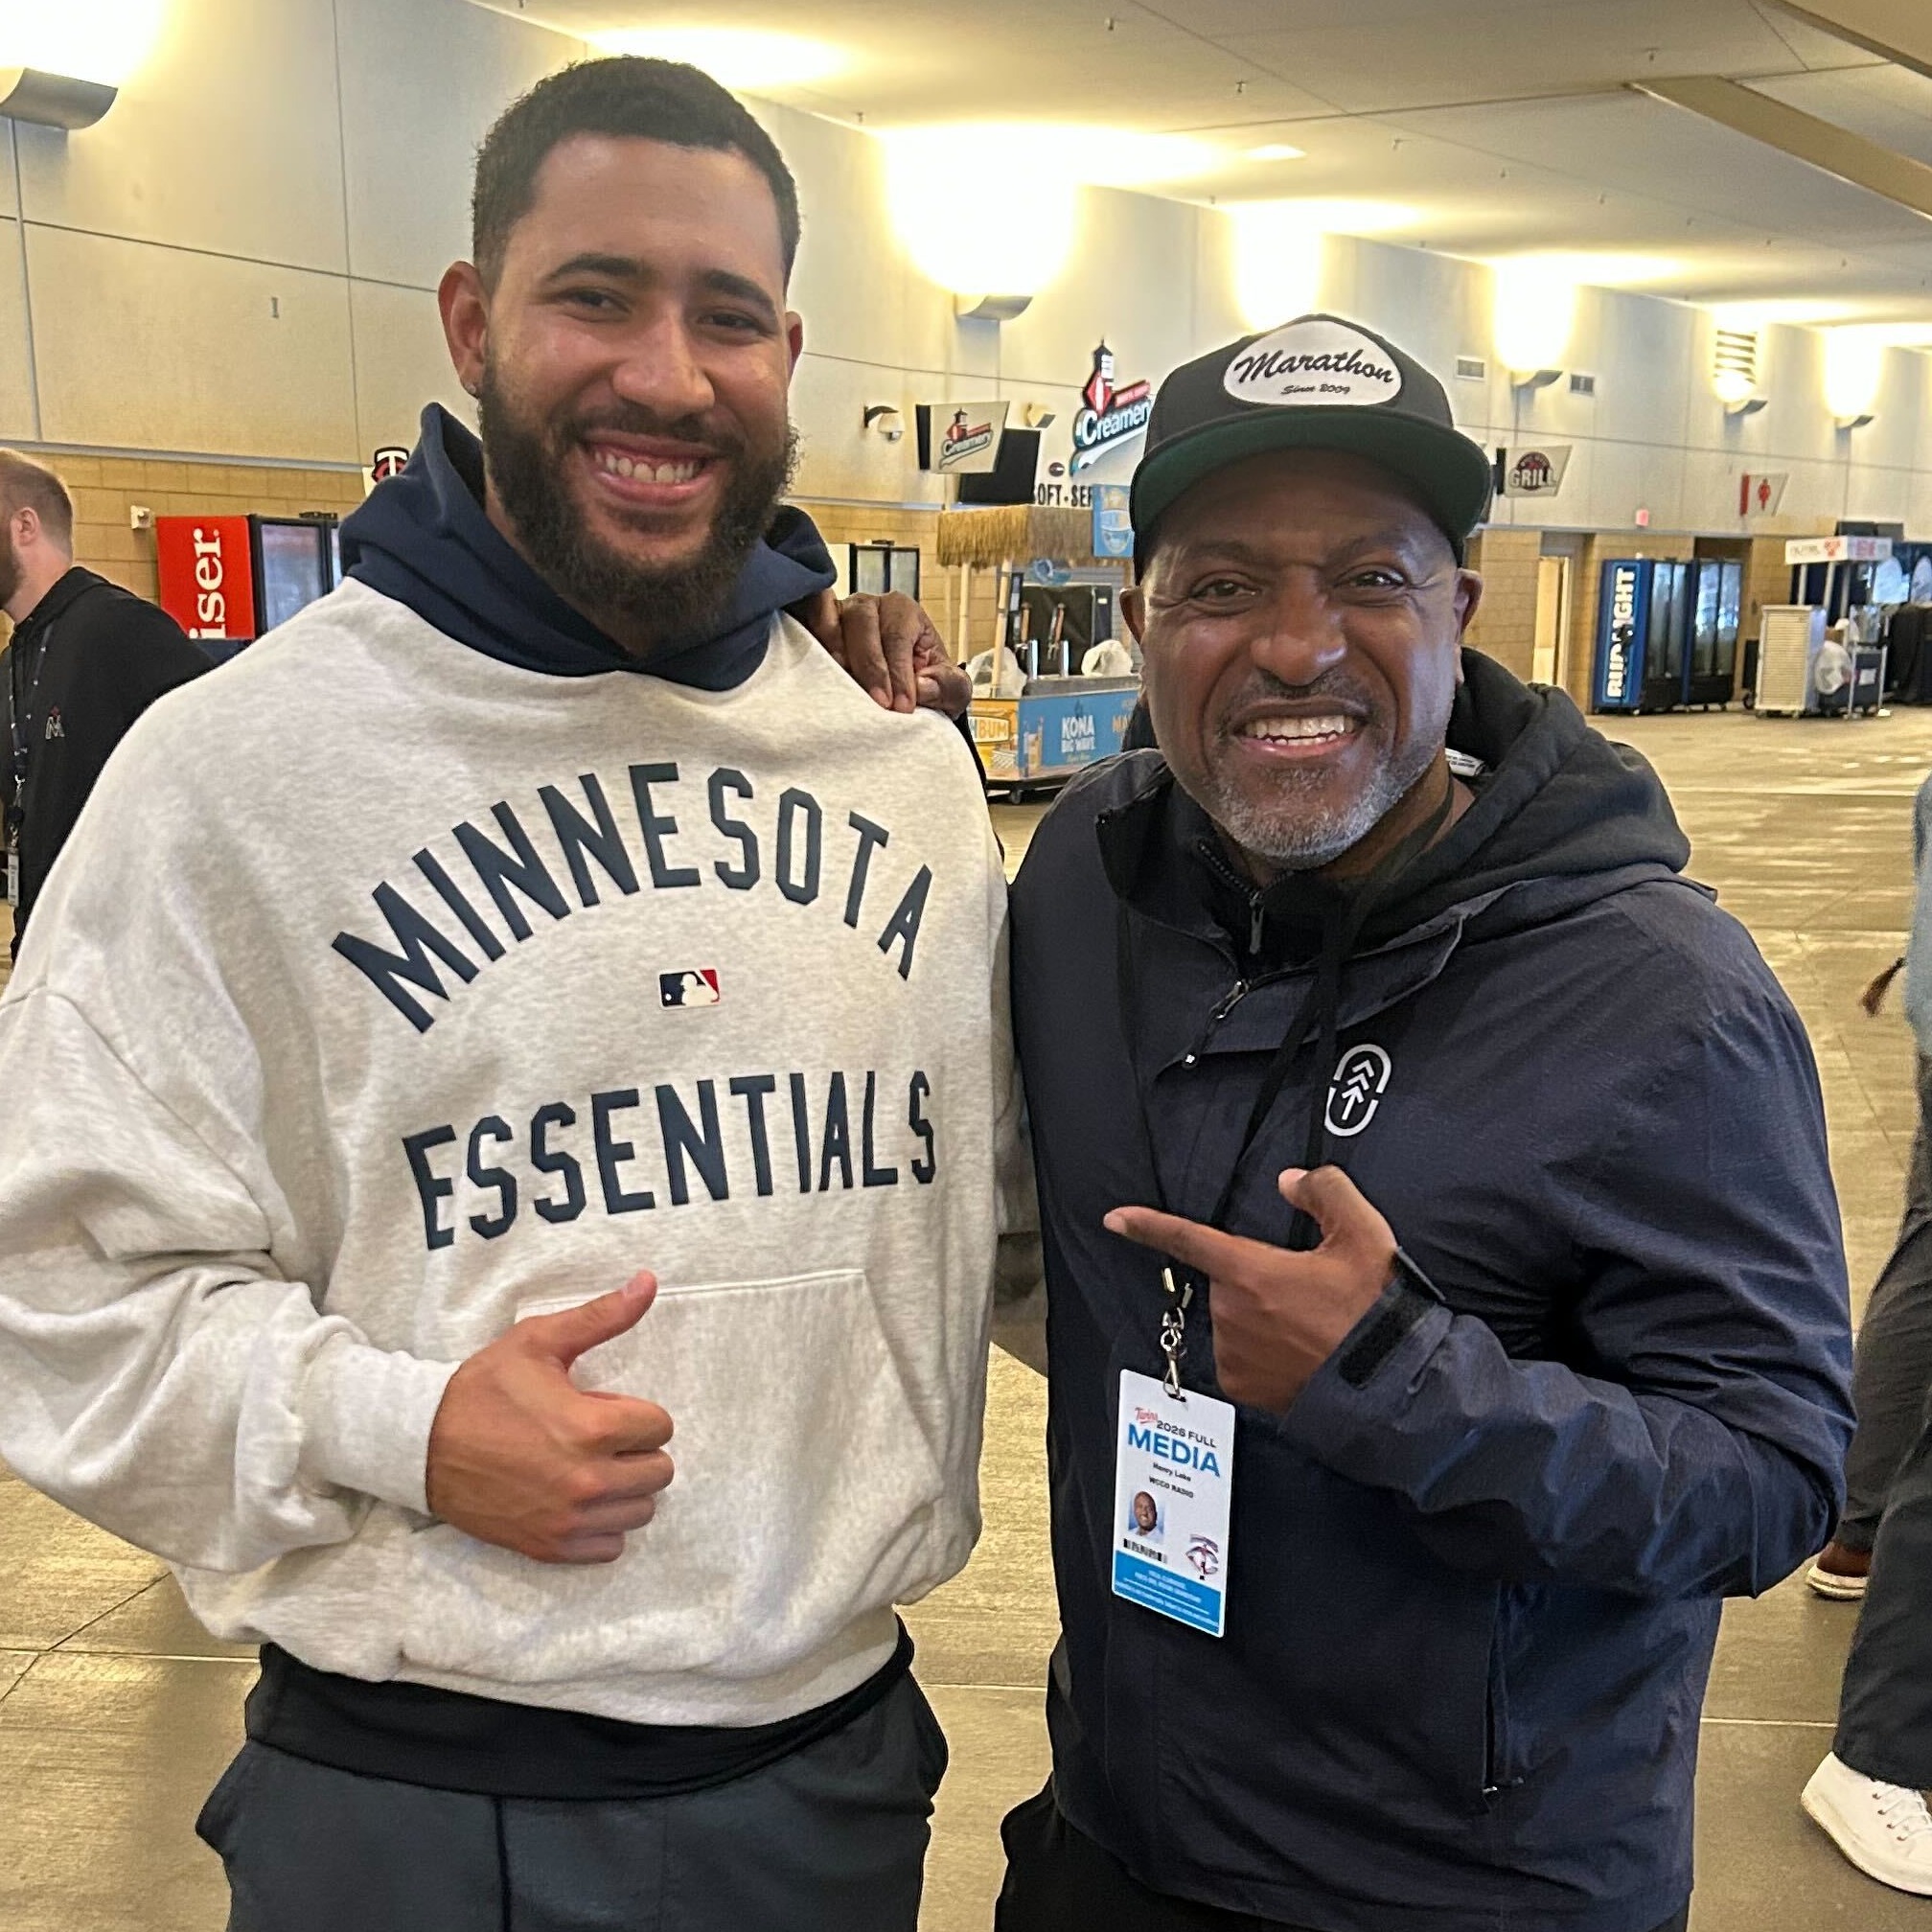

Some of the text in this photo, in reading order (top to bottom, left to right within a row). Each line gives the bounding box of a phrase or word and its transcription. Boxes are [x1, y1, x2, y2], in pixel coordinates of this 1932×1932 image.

[1233, 349, 1393, 383] Marathon
[1280, 383, 1351, 395] Since 2009
[1082, 400, 1151, 446] Creamer
[1509, 469, 1557, 488] GRILL
[1062, 715, 1095, 739] KONA
[331, 762, 933, 1034] MINNESOTA
[402, 1070, 936, 1251] ESSENTIALS
[1128, 1423, 1220, 1478] MEDIA
[1156, 1420, 1216, 1448] 2026 FULL
